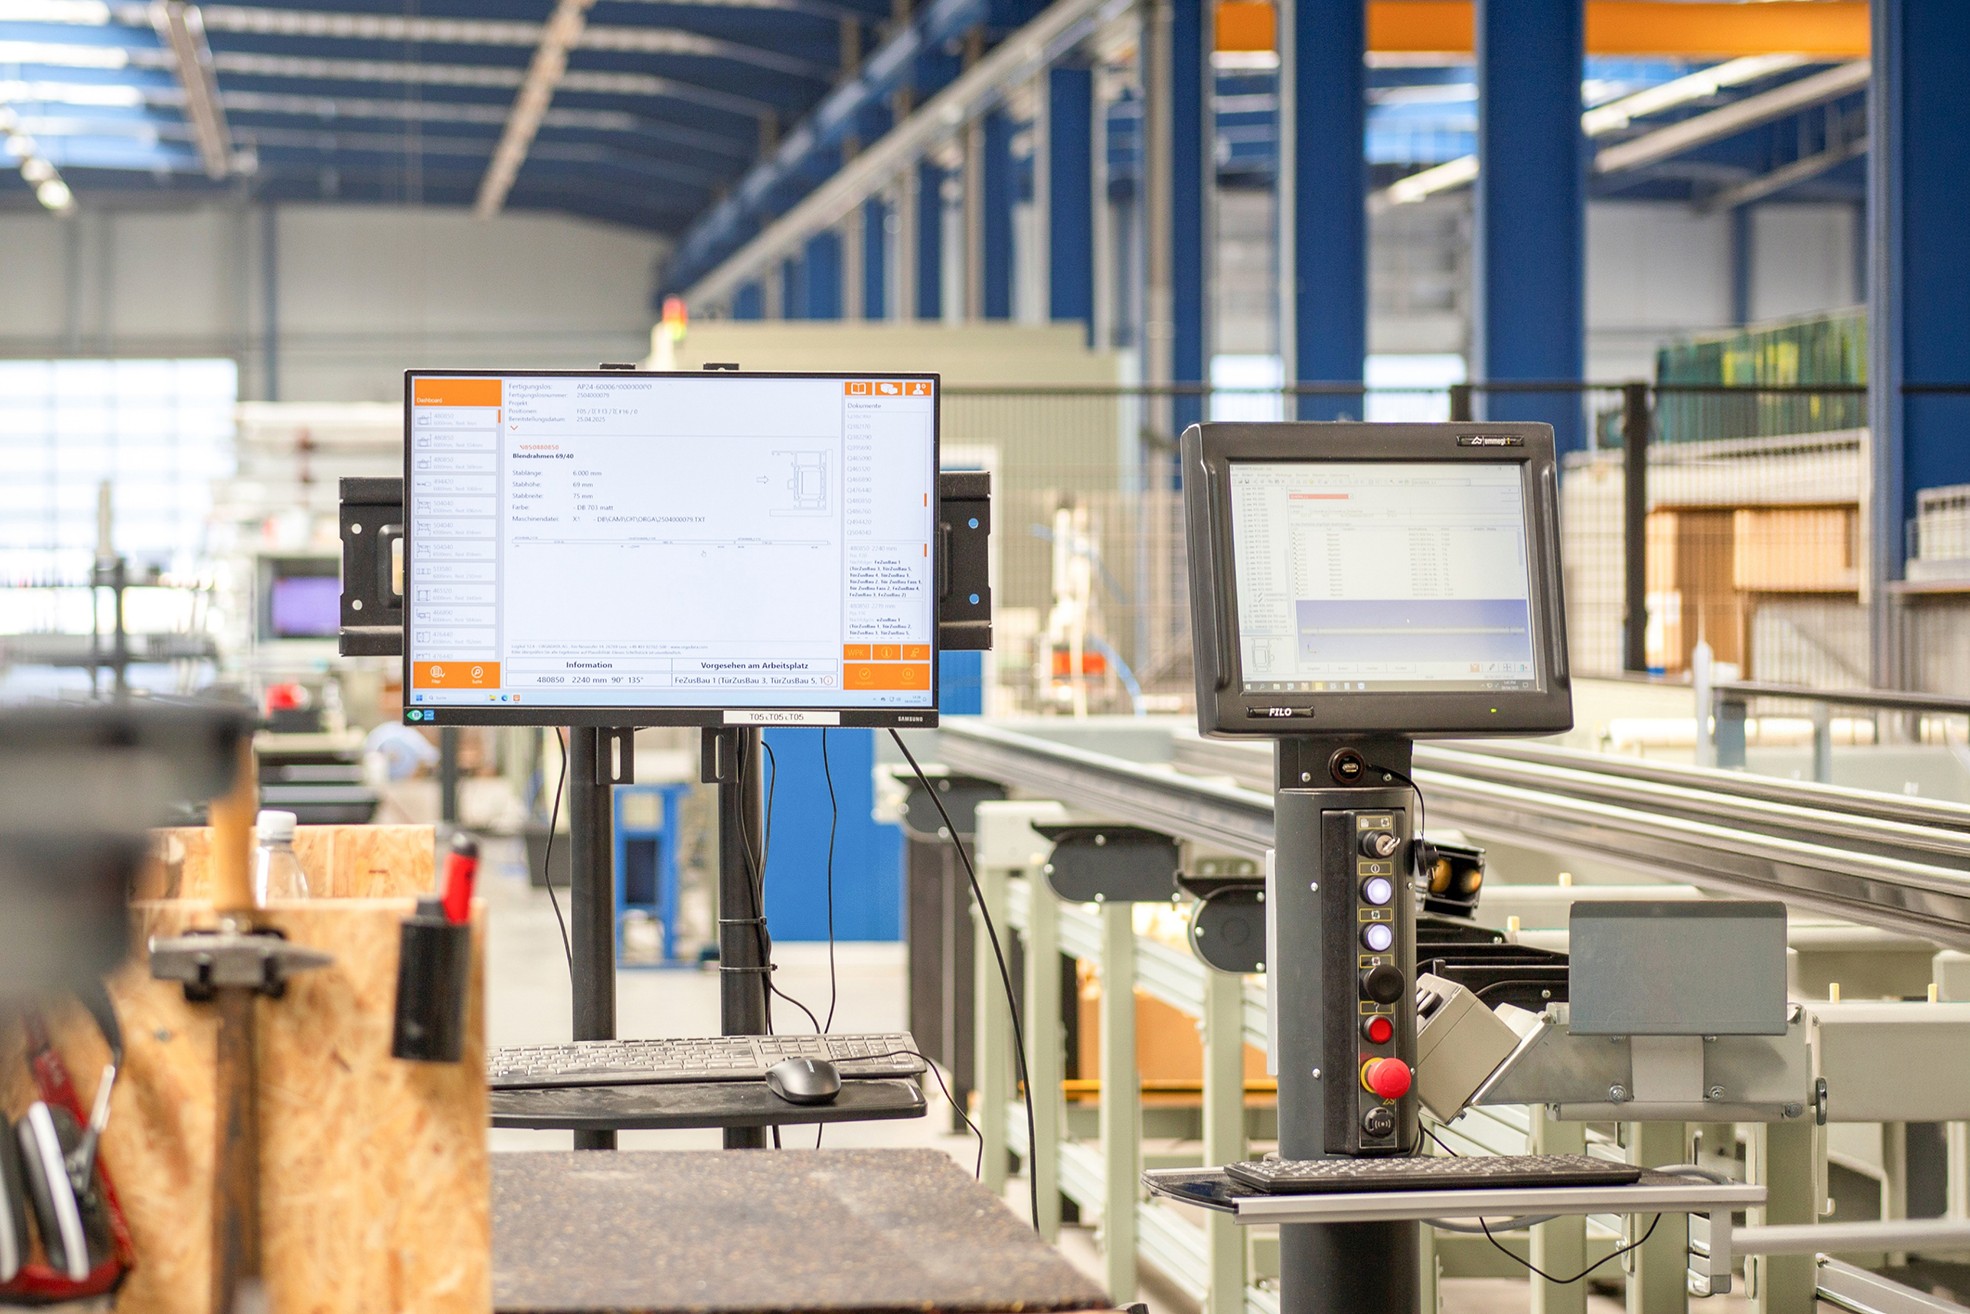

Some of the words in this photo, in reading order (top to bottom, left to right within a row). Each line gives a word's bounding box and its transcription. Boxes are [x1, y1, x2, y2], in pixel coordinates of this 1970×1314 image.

[566, 661, 613, 669] Information
[701, 662, 746, 670] Vorgesehen
[762, 662, 808, 671] Arbeitsplatz
[811, 677, 817, 685] 5,
[1269, 708, 1292, 717] FILO
[749, 713, 764, 721] T05
[769, 713, 784, 721] T05
[789, 713, 804, 721] T05
